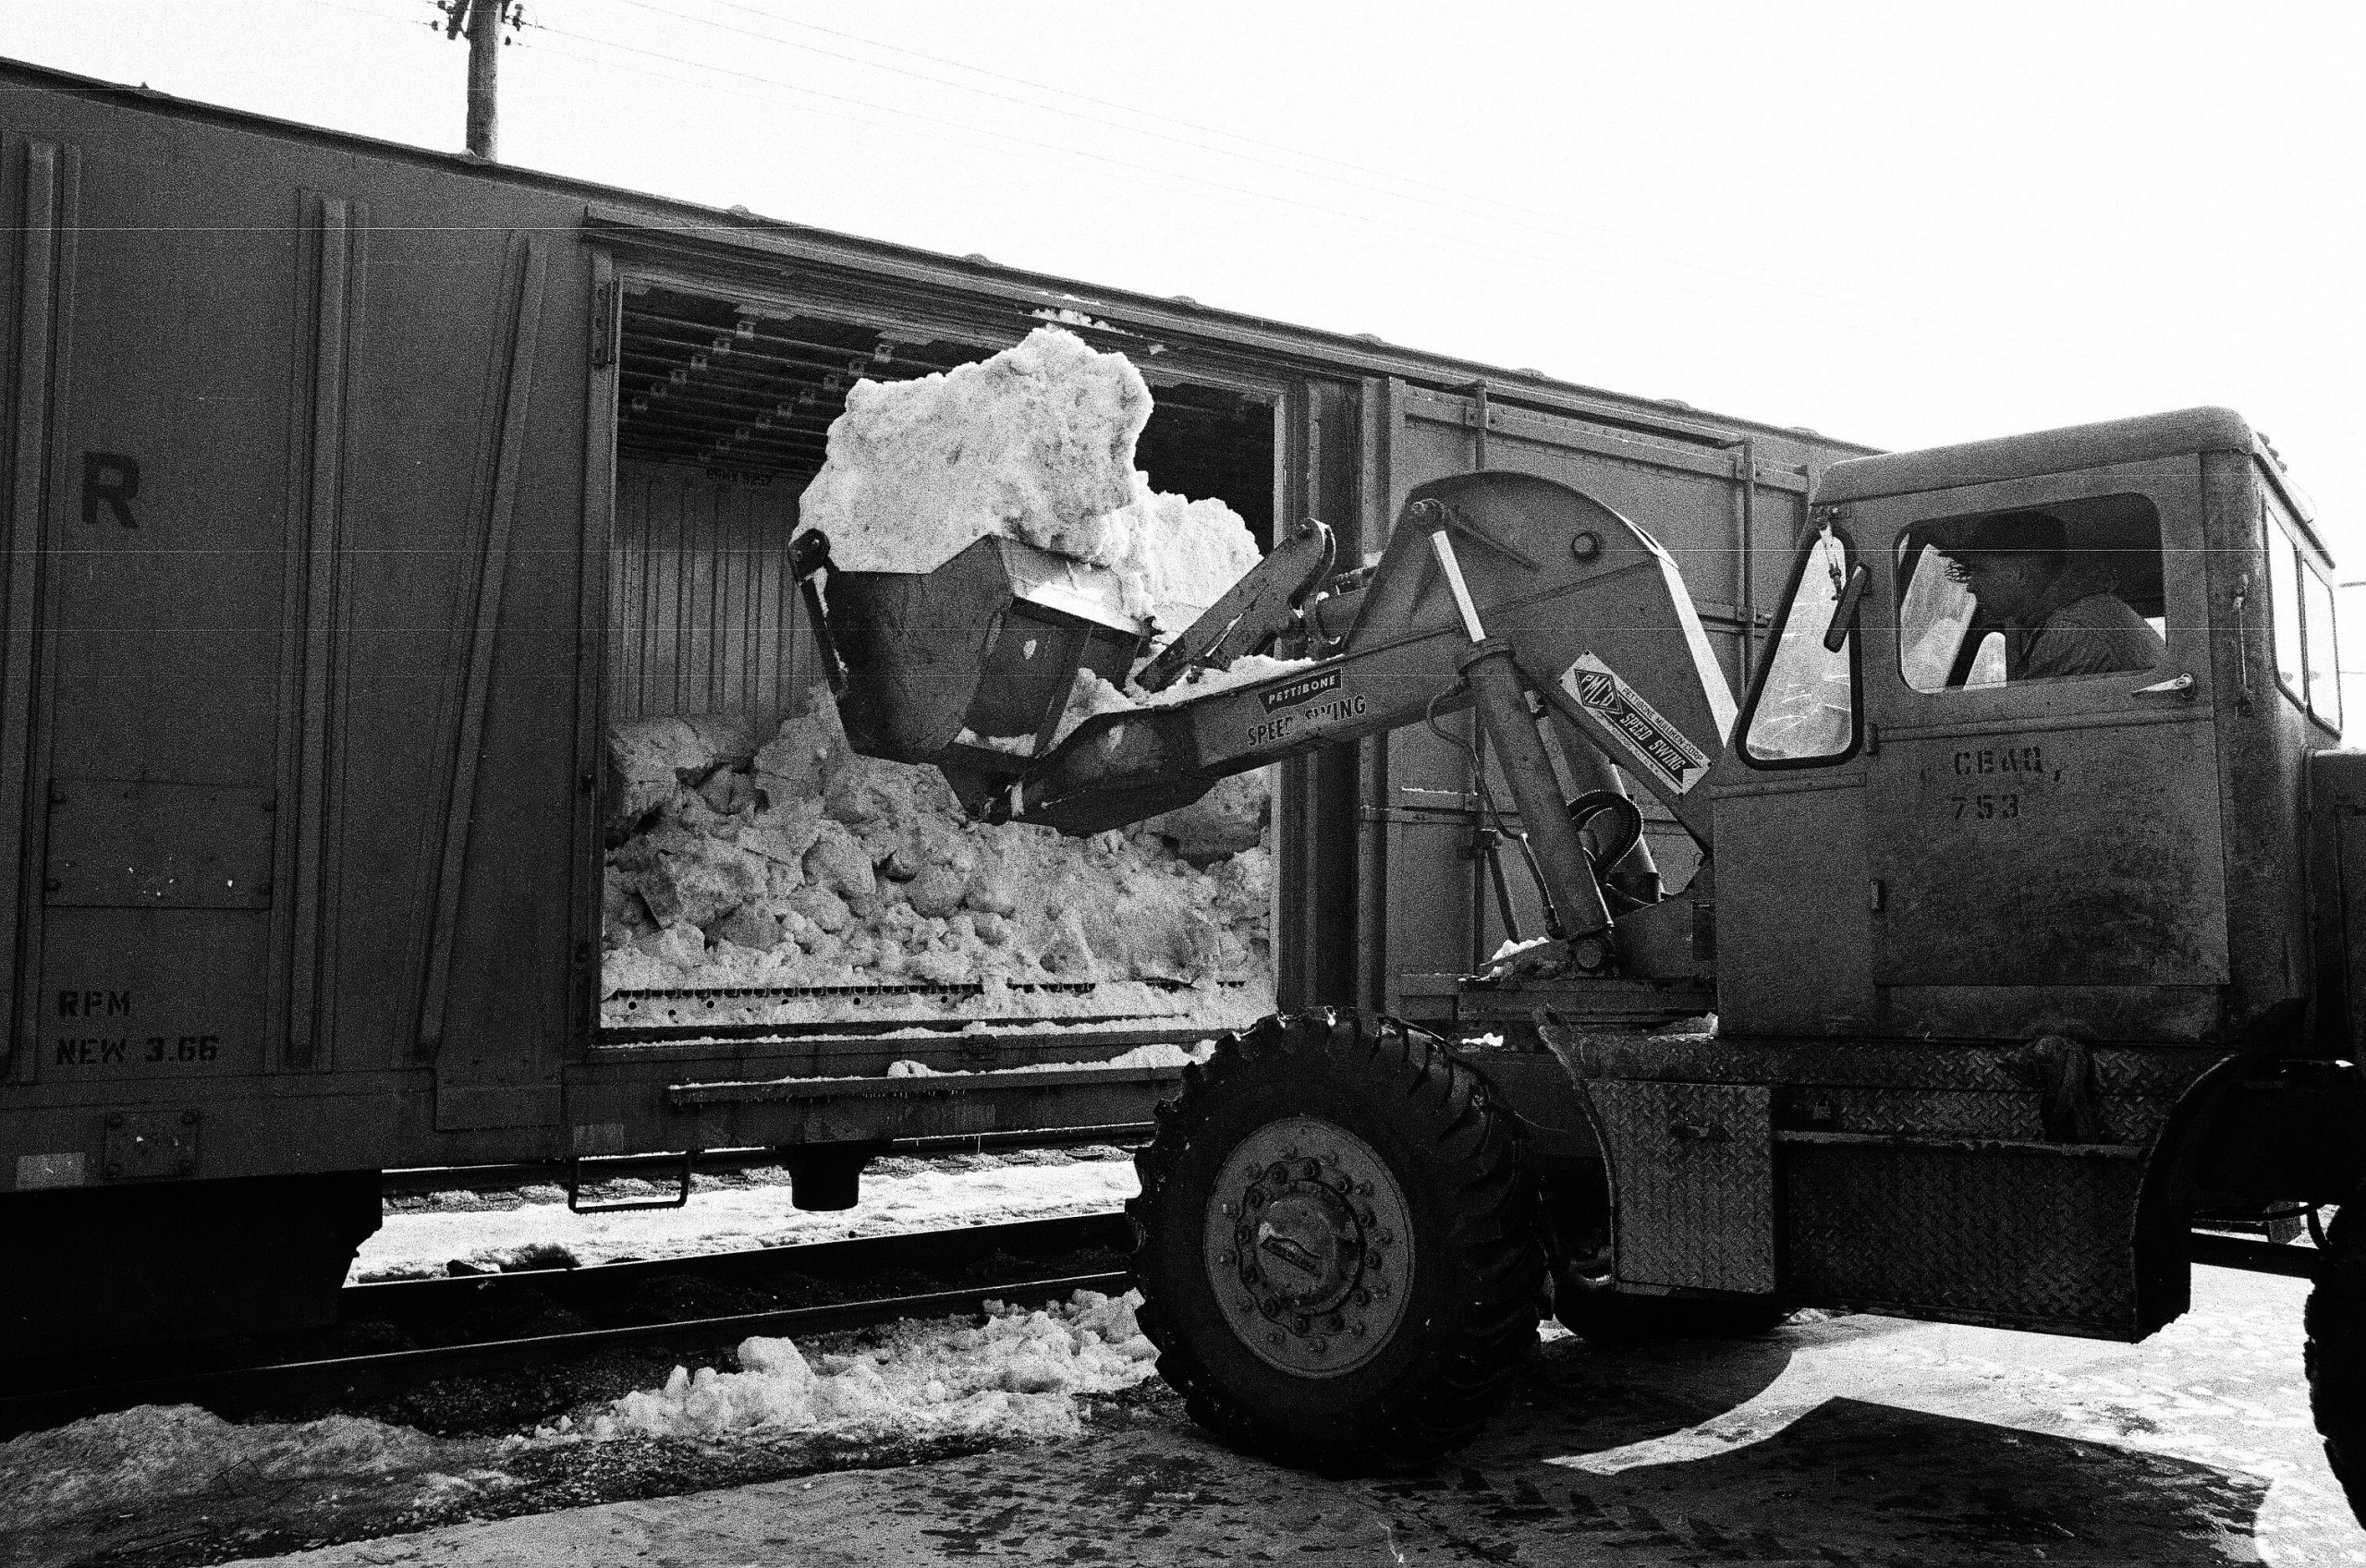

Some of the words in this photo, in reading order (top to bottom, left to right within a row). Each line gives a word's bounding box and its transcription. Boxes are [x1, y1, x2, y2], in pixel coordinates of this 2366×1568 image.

[81, 451, 139, 529] R
[1269, 675, 1335, 704] PETTIBONE
[1621, 687, 1654, 719] PETTIBONE
[1654, 716, 1685, 746] MULLIKEN
[1619, 712, 1653, 741] SPEED
[1649, 739, 1686, 771] SWING
[1951, 794, 2018, 820] 753
[59, 991, 130, 1016] RPM
[56, 1038, 126, 1064] NEW
[145, 1035, 218, 1062] 3.66
